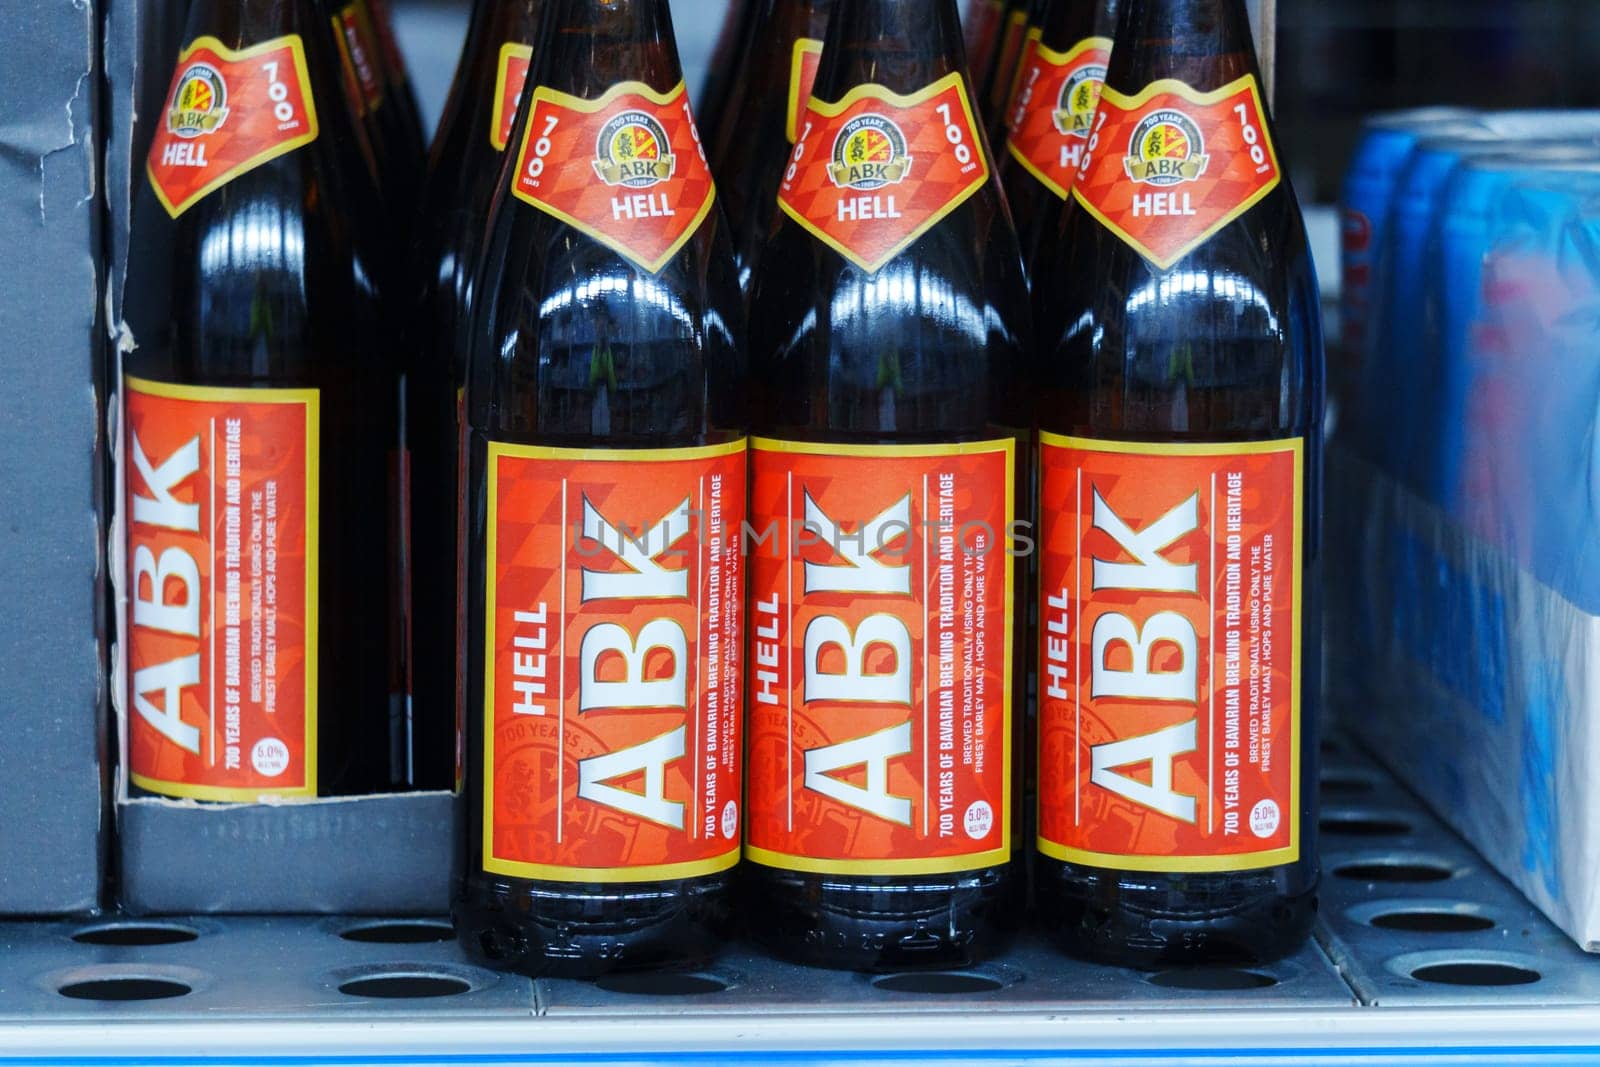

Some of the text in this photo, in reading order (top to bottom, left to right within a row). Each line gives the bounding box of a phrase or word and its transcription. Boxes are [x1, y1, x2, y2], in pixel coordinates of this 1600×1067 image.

[262, 61, 294, 122] 700
[177, 112, 208, 129] ABK
[528, 115, 559, 178] 700
[610, 115, 648, 130] 700 YEARS
[847, 118, 884, 133] 700 YEARS
[936, 104, 970, 164] 700
[1144, 113, 1182, 128] 700 YEARS
[1234, 103, 1264, 165] 700
[162, 143, 208, 167] HELL
[621, 161, 658, 179] ABK
[849, 164, 888, 181] ABK
[1145, 160, 1184, 177] ABK
[611, 193, 675, 220] HELL
[838, 196, 901, 222] HELL
[1133, 192, 1195, 217] HELL
[132, 430, 201, 756] ABK
[225, 418, 241, 770] 700 YEARS OF BAVARIAN BREWING TRADITION AND HERITAGE
[251, 491, 262, 703] BREWED TRADITIONALLY USING ONLY THE
[266, 480, 276, 713] FINEST BARLEY MALT, HOPS AND PURE WATER
[963, 569, 973, 598] ONLY
[975, 576, 985, 602] PURE
[963, 601, 973, 634] USING
[975, 605, 985, 628] AND
[513, 602, 547, 716] HELL
[577, 489, 691, 832] ABK
[705, 474, 721, 839] 700 YEARS OF BAVARIAN BREWING TRADITION AND HERITAGE
[721, 547, 732, 764] BREWED TRADITIONALLY USING ONLY THE
[757, 592, 778, 705] HELL
[803, 483, 912, 827] ABK
[940, 473, 954, 837] 700 YEARS OF BAVARIAN BREWING TRADITION AND HERITAGE
[975, 631, 985, 660] HOPS
[1047, 588, 1068, 700] HELL
[1091, 480, 1200, 824] ABK
[1224, 472, 1241, 836] 700 YEARS OF BAVARIAN BREWING TRADITION AND HERITAGE
[1249, 546, 1260, 763] BREWED TRADITIONALLY USING ONLY THE
[1261, 534, 1272, 772] FINEST BARLEY MALT, HOPS AND PURE WATER
[963, 638, 973, 717] TRADITIONALLY
[975, 663, 985, 695] MALT,
[963, 720, 973, 764] BREWED
[975, 699, 985, 735] BARLEY
[975, 738, 985, 773] FINEST
[1255, 806, 1276, 820] 5.0%
